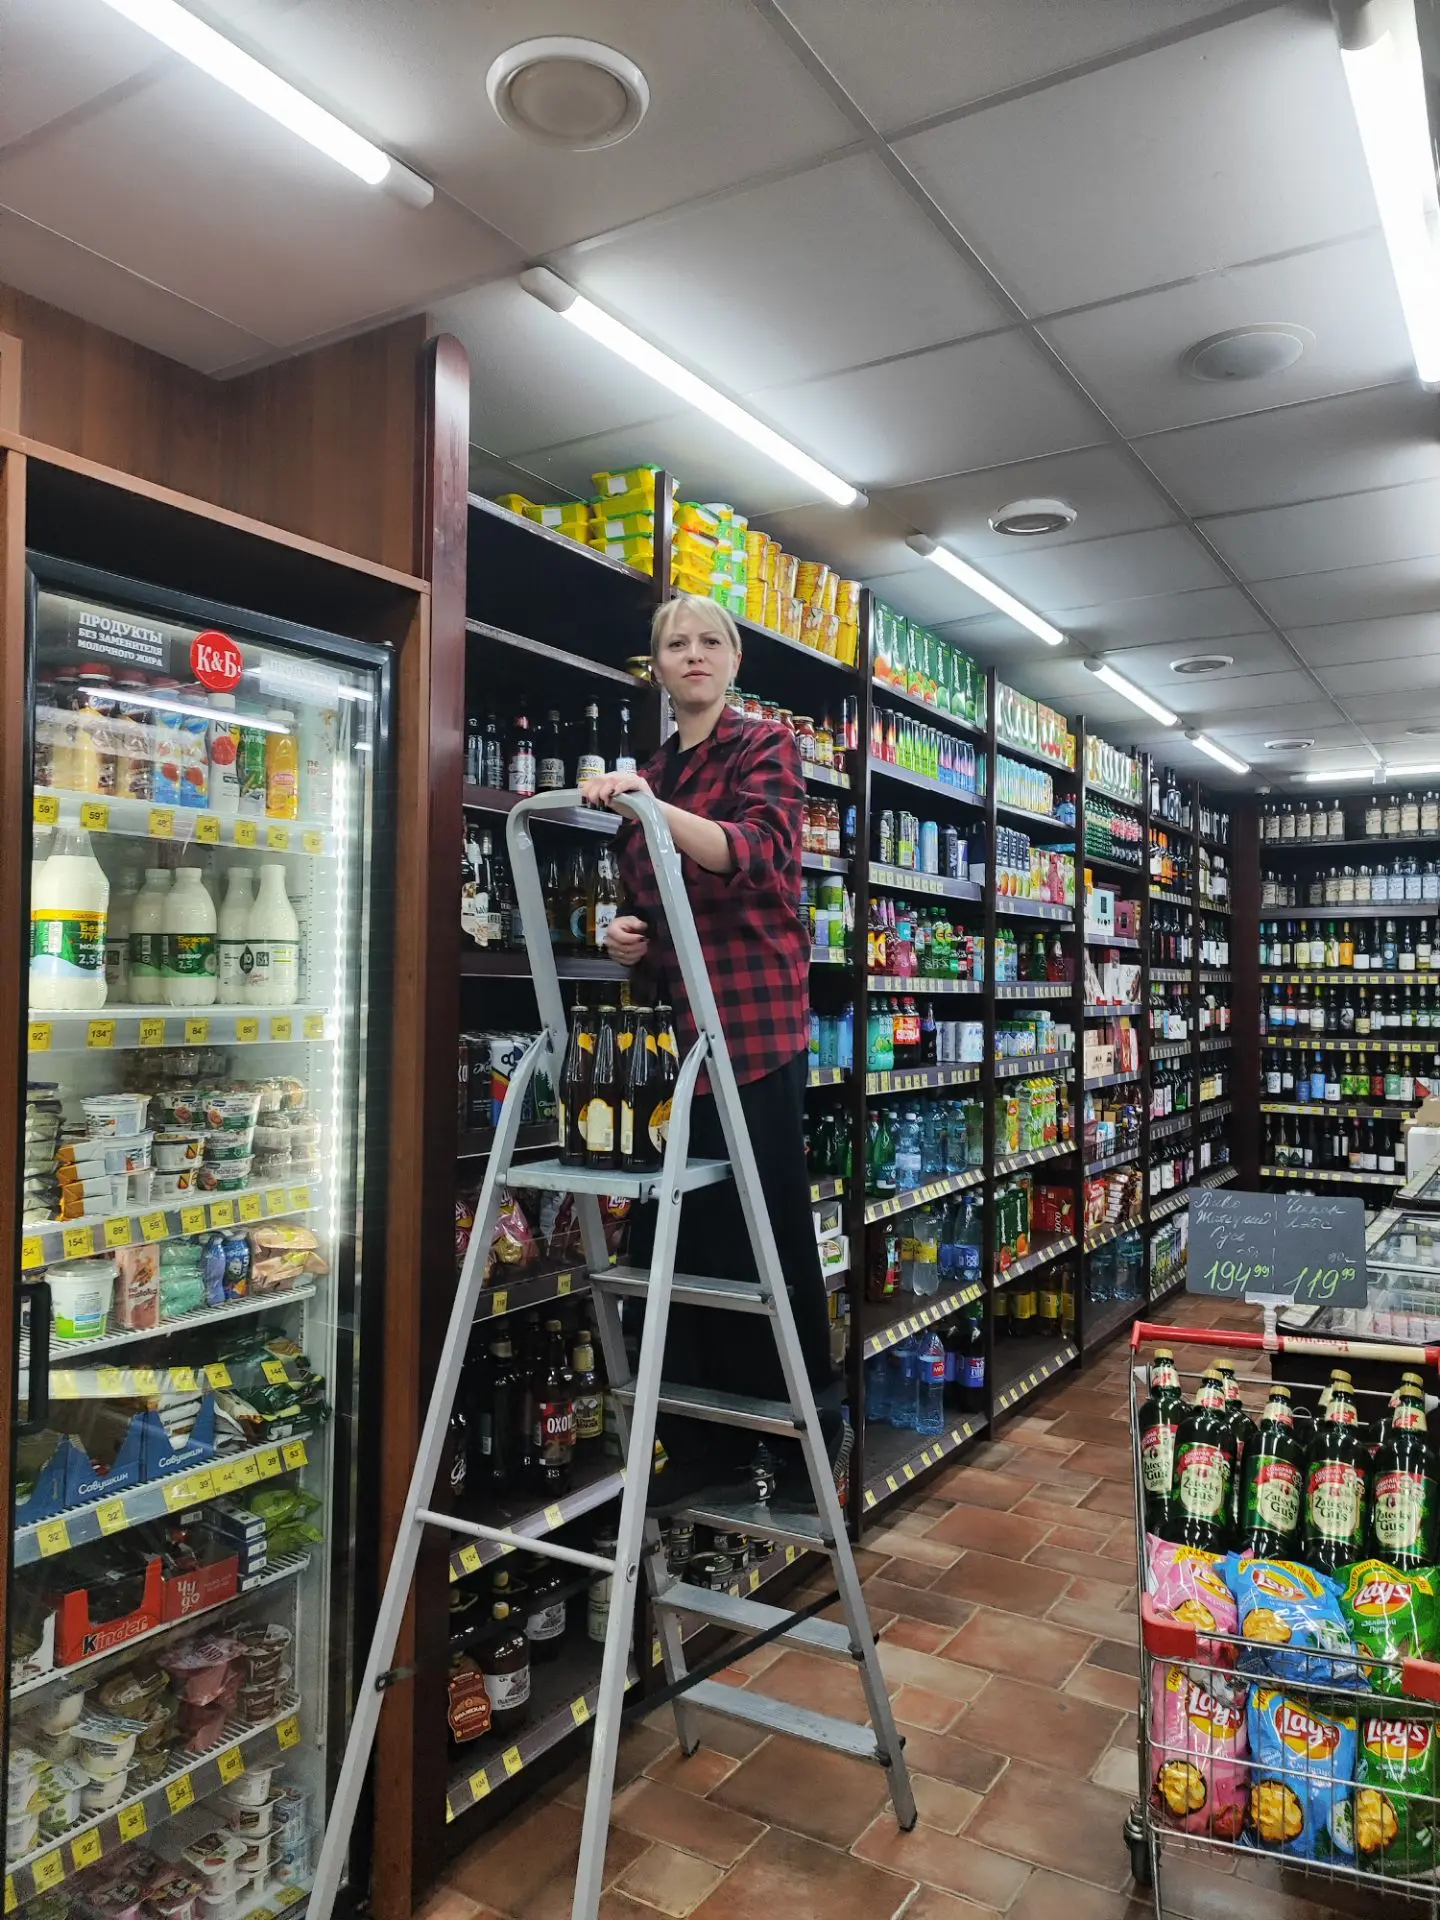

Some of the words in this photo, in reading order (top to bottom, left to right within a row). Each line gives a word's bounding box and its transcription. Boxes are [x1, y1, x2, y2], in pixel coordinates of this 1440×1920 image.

[78, 628, 97, 640] БЕЗ
[98, 634, 163, 656] ЗАМЕНИТЕЛЯ
[79, 612, 163, 644] ПРОДУКТЫ
[77, 639, 135, 660] МОЛОЧНОГО
[136, 655, 163, 667] ЖИРА
[1283, 1267, 1339, 1299] 119
[83, 1616, 149, 1657] Kinder
